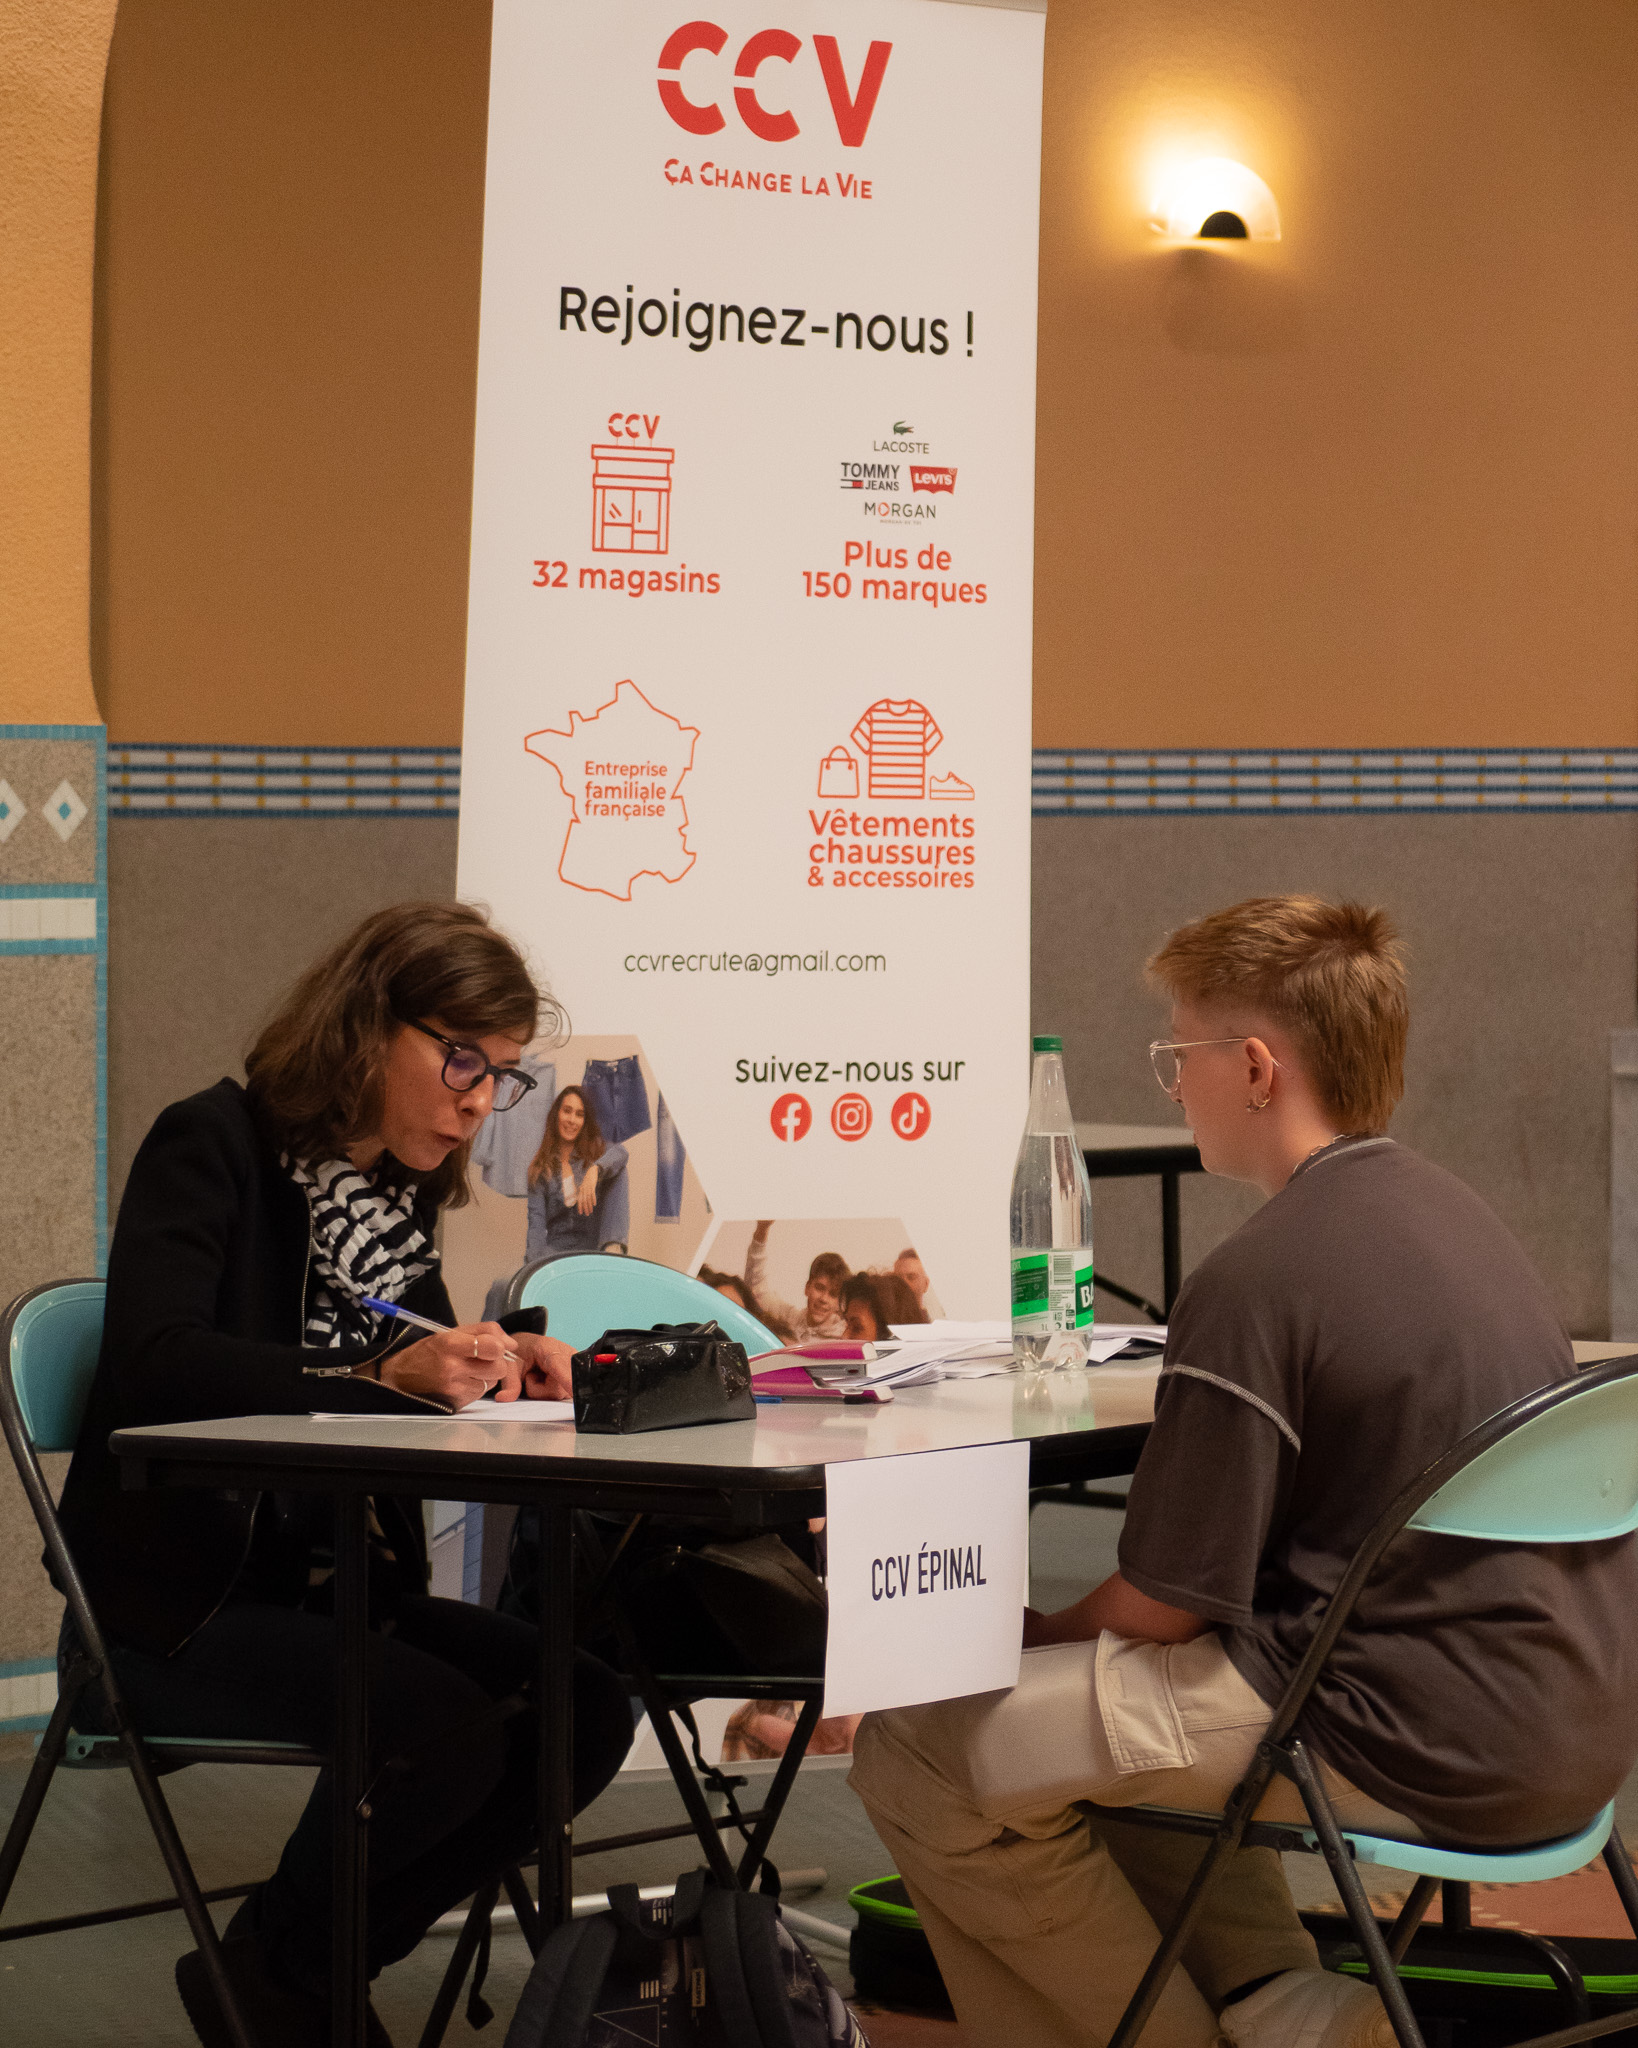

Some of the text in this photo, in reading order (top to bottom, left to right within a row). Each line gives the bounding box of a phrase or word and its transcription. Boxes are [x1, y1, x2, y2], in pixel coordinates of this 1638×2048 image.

[657, 21, 893, 147] CCV
[664, 158, 873, 199] ÇA CHANGE LA VIE
[559, 284, 974, 358] Rejoignez-nous !
[607, 412, 660, 439] CCV
[873, 440, 930, 454] LACOSTE
[841, 461, 900, 479] TOMMY
[864, 480, 900, 491] JEANS
[864, 502, 936, 518] MORGAN
[844, 540, 952, 571] Plus de
[532, 560, 721, 598] 32 magasins
[803, 571, 988, 608] 150 marques
[585, 760, 668, 779] Entreprise
[585, 780, 667, 800] familiale
[585, 799, 666, 821] française
[808, 808, 975, 838] Vêtements
[809, 837, 975, 865] chaussures
[808, 864, 975, 888] & accessoires
[624, 950, 887, 976] ccvrecrute@gmail.com
[735, 1056, 966, 1083] Suivez-nous sur
[871, 1541, 987, 1601] CCV ÉPINAL
